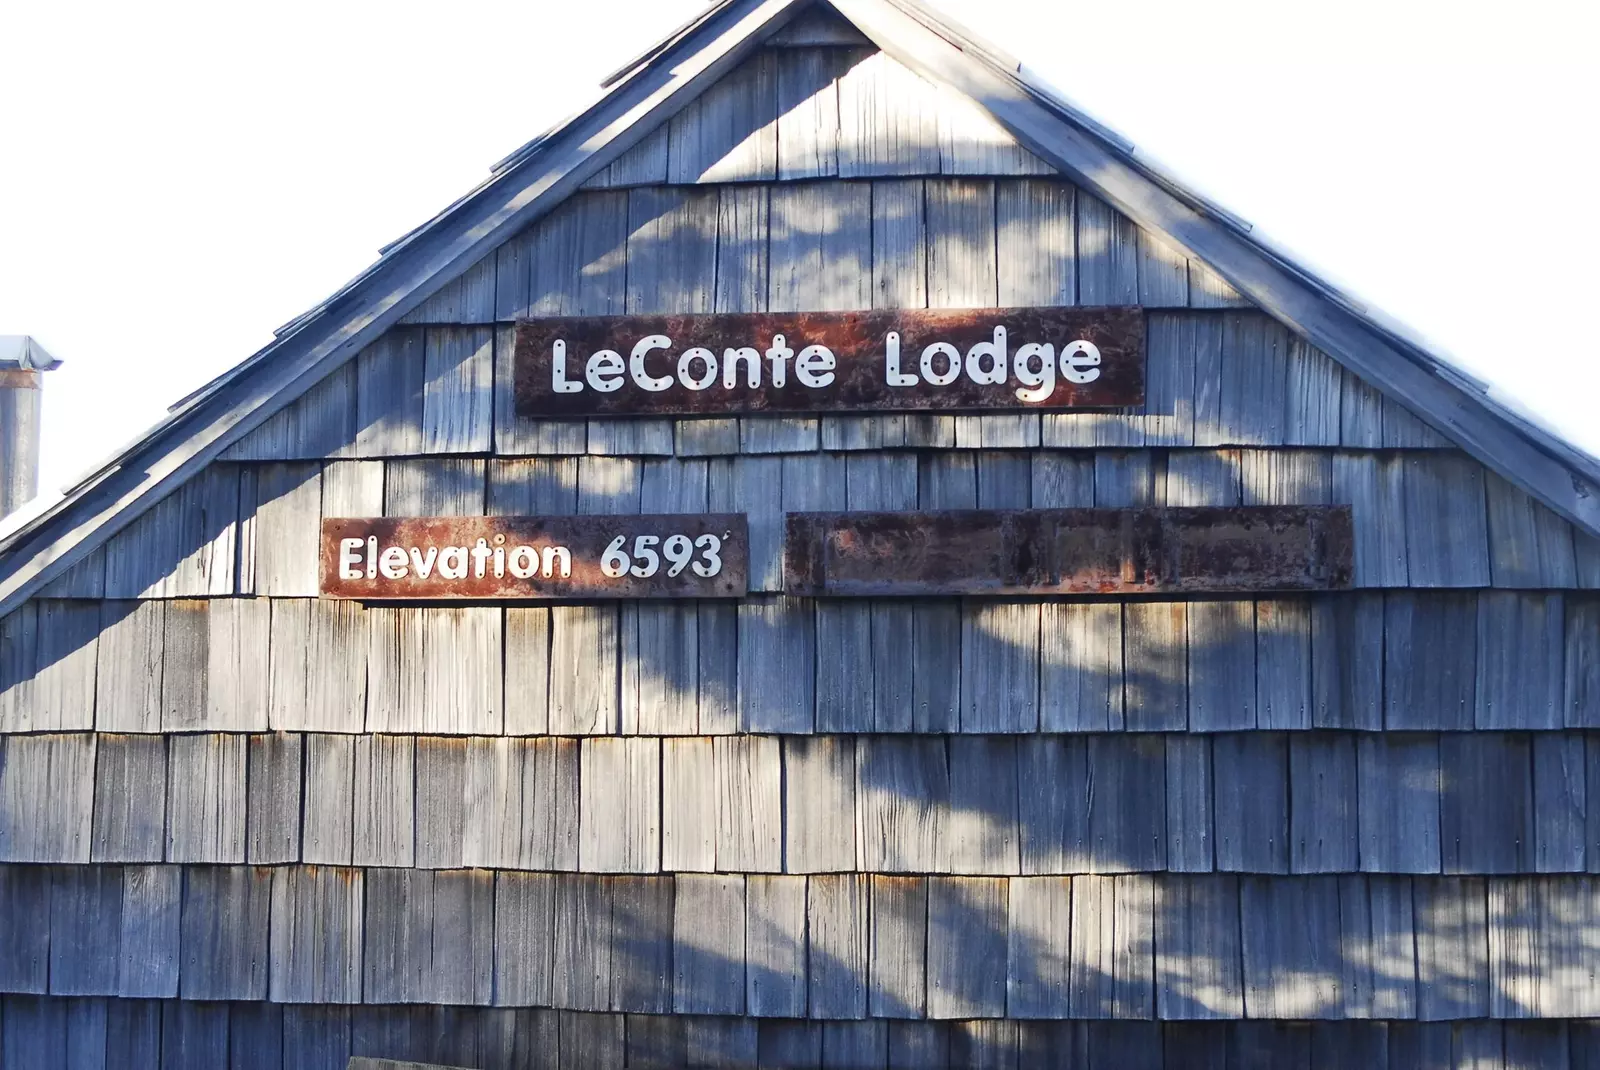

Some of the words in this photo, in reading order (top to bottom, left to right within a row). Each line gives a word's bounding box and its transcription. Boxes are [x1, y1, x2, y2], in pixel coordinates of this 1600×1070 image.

[552, 334, 838, 394] LeConte
[885, 324, 1103, 404] Lodge
[337, 533, 573, 581] Elevation
